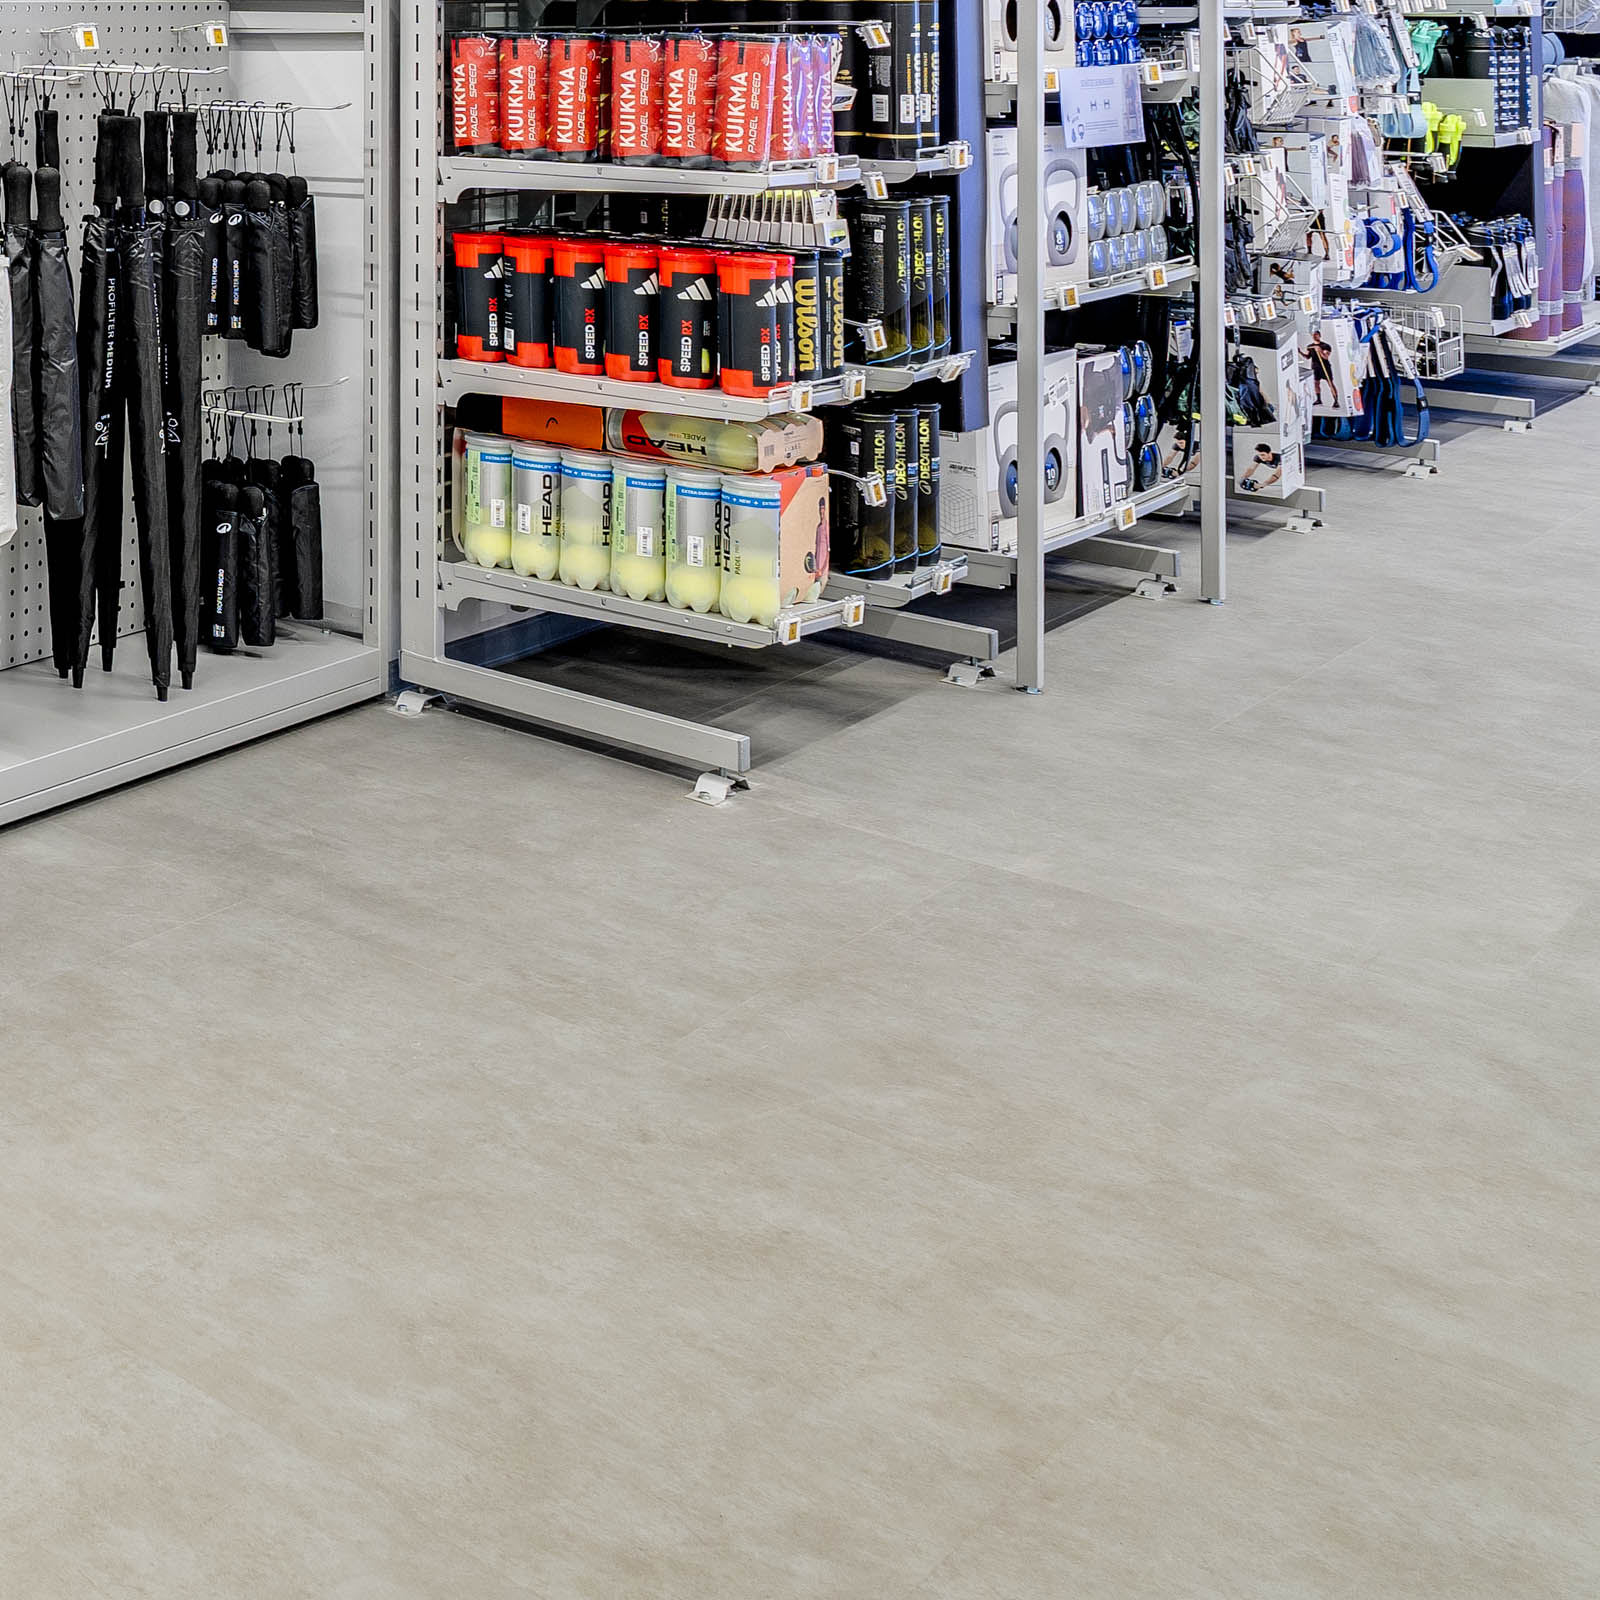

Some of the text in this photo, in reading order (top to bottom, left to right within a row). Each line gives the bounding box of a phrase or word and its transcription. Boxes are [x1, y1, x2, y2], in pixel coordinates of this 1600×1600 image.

[454, 63, 467, 138] KUIKMA
[468, 64, 479, 138] PADEL SPEED
[508, 65, 524, 141] KUIKMA
[527, 65, 537, 141] PADEL SPEED
[556, 66, 575, 144] KUIKMA
[577, 66, 588, 144] PADEL SPEED
[619, 69, 637, 147] KUIKMA
[640, 68, 650, 147] PADEL SPEED
[666, 68, 685, 148] KUIKMA
[687, 68, 698, 148] PADEL SPEED
[725, 71, 748, 153] KUIKMA
[748, 72, 761, 153] PADEL SPEED
[104, 278, 116, 388] PROFILTER MEDIUM
[488, 297, 498, 347] SPEED RX
[584, 308, 595, 359] SPEED RX
[638, 314, 649, 366] SPEED RX
[680, 319, 693, 373] SPEED RX
[760, 328, 770, 382] SPEED RX
[794, 277, 818, 372] Wilson
[626, 434, 708, 456] HEAD
[682, 432, 706, 442] PADEL
[874, 429, 885, 483] CATHLON
[895, 423, 906, 485] DECATHLON
[919, 418, 929, 480] DECATHLON
[542, 474, 552, 536] HEAD
[1046, 468, 1056, 480] 10
[602, 482, 612, 547] HEAD
[714, 500, 722, 567] HEAD
[723, 505, 731, 572] HEAD
